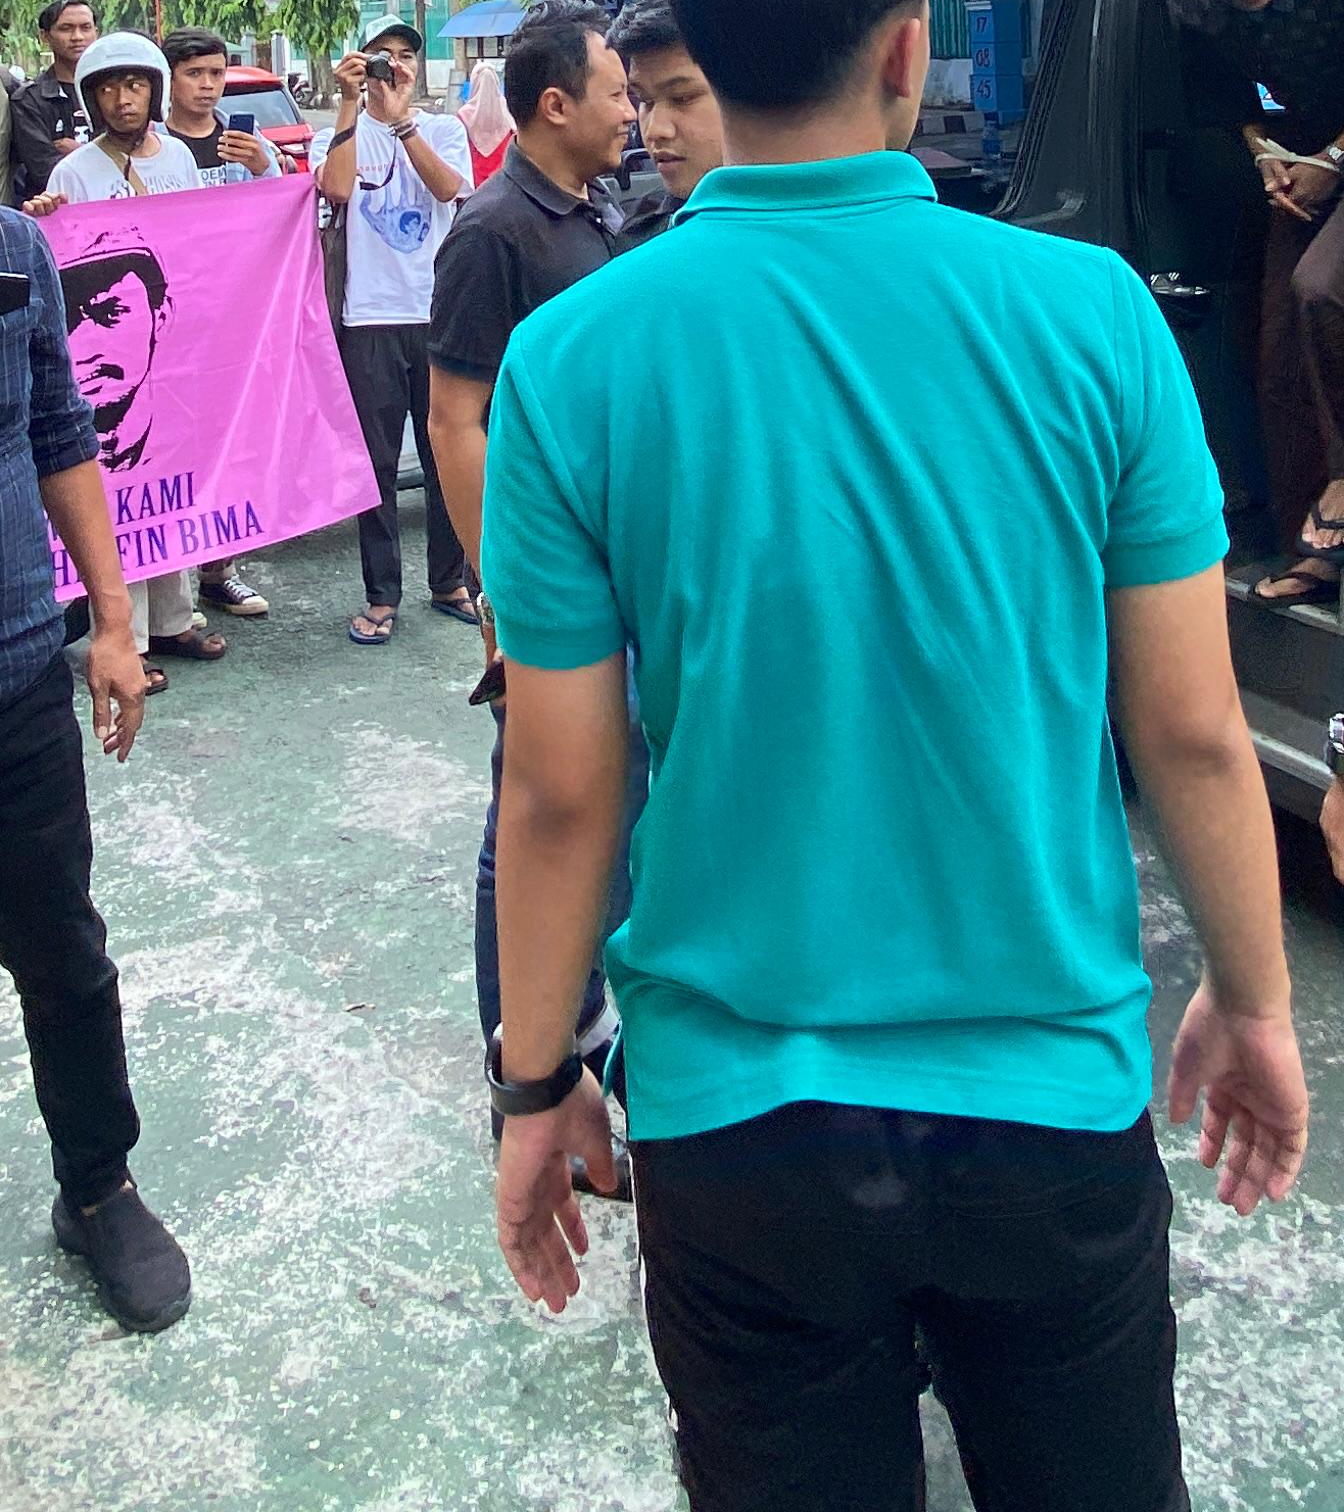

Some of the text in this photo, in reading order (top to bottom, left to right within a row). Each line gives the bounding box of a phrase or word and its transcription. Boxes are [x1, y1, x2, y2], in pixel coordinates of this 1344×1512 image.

[975, 16, 988, 33] 17
[975, 47, 991, 68] 08
[976, 79, 992, 100] 45
[114, 471, 197, 526] KAMI
[176, 500, 266, 556] BIMA
